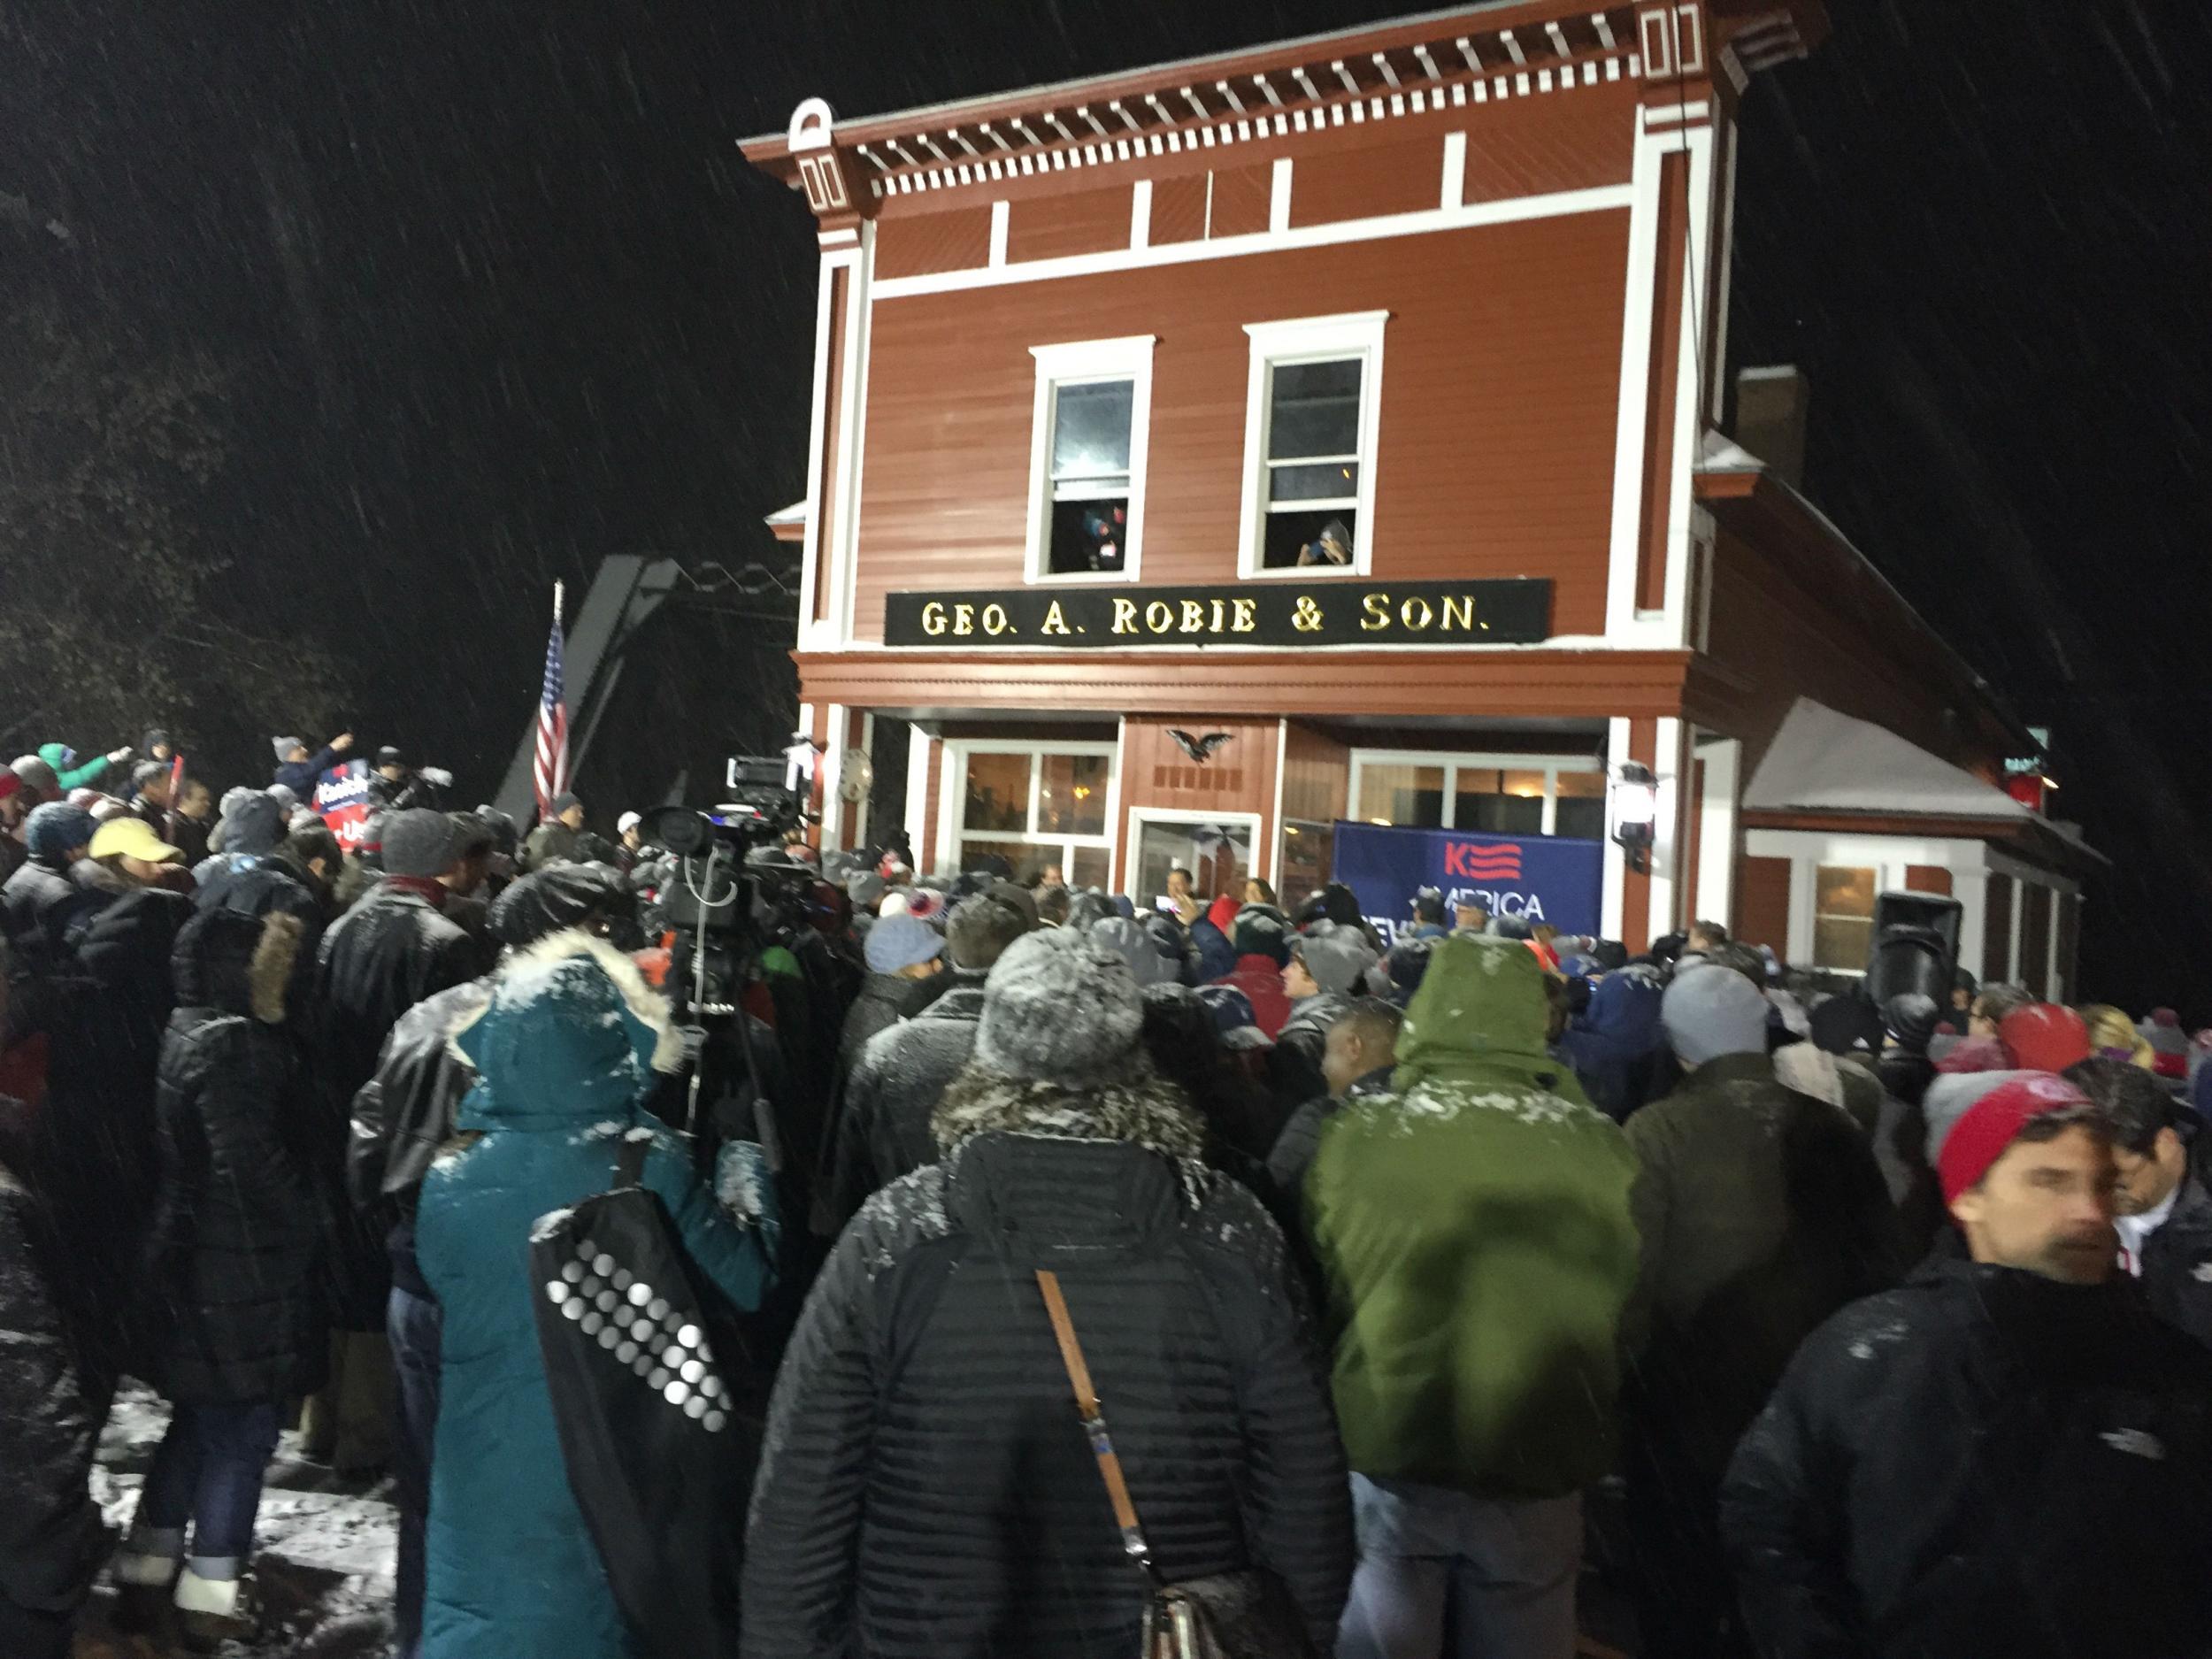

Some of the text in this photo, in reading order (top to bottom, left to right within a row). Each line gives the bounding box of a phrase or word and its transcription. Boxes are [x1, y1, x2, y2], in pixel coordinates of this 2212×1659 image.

[922, 594, 1489, 635] GEO. A. ROBIE & SON.
[1409, 885, 1546, 921] MRICA
